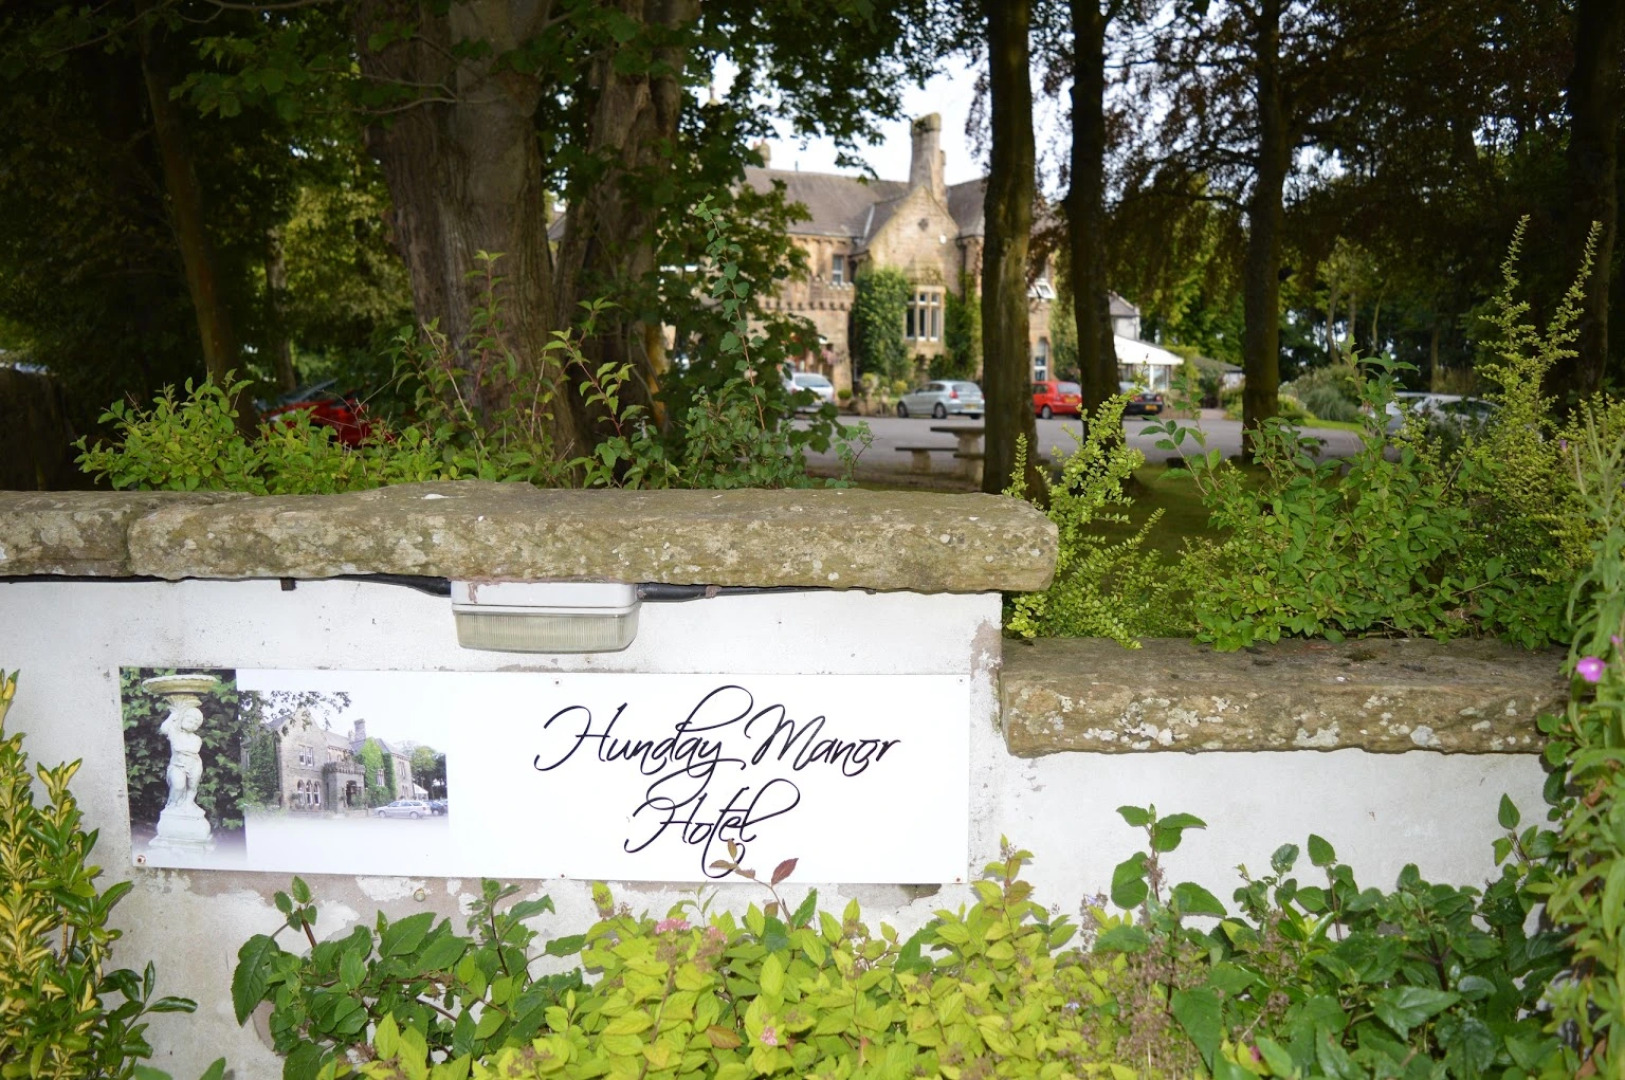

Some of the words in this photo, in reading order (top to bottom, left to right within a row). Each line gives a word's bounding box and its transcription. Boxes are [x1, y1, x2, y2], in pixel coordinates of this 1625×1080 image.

[534, 685, 753, 810] Hunday
[744, 704, 901, 777] Manor
[624, 778, 800, 878] Hotel
